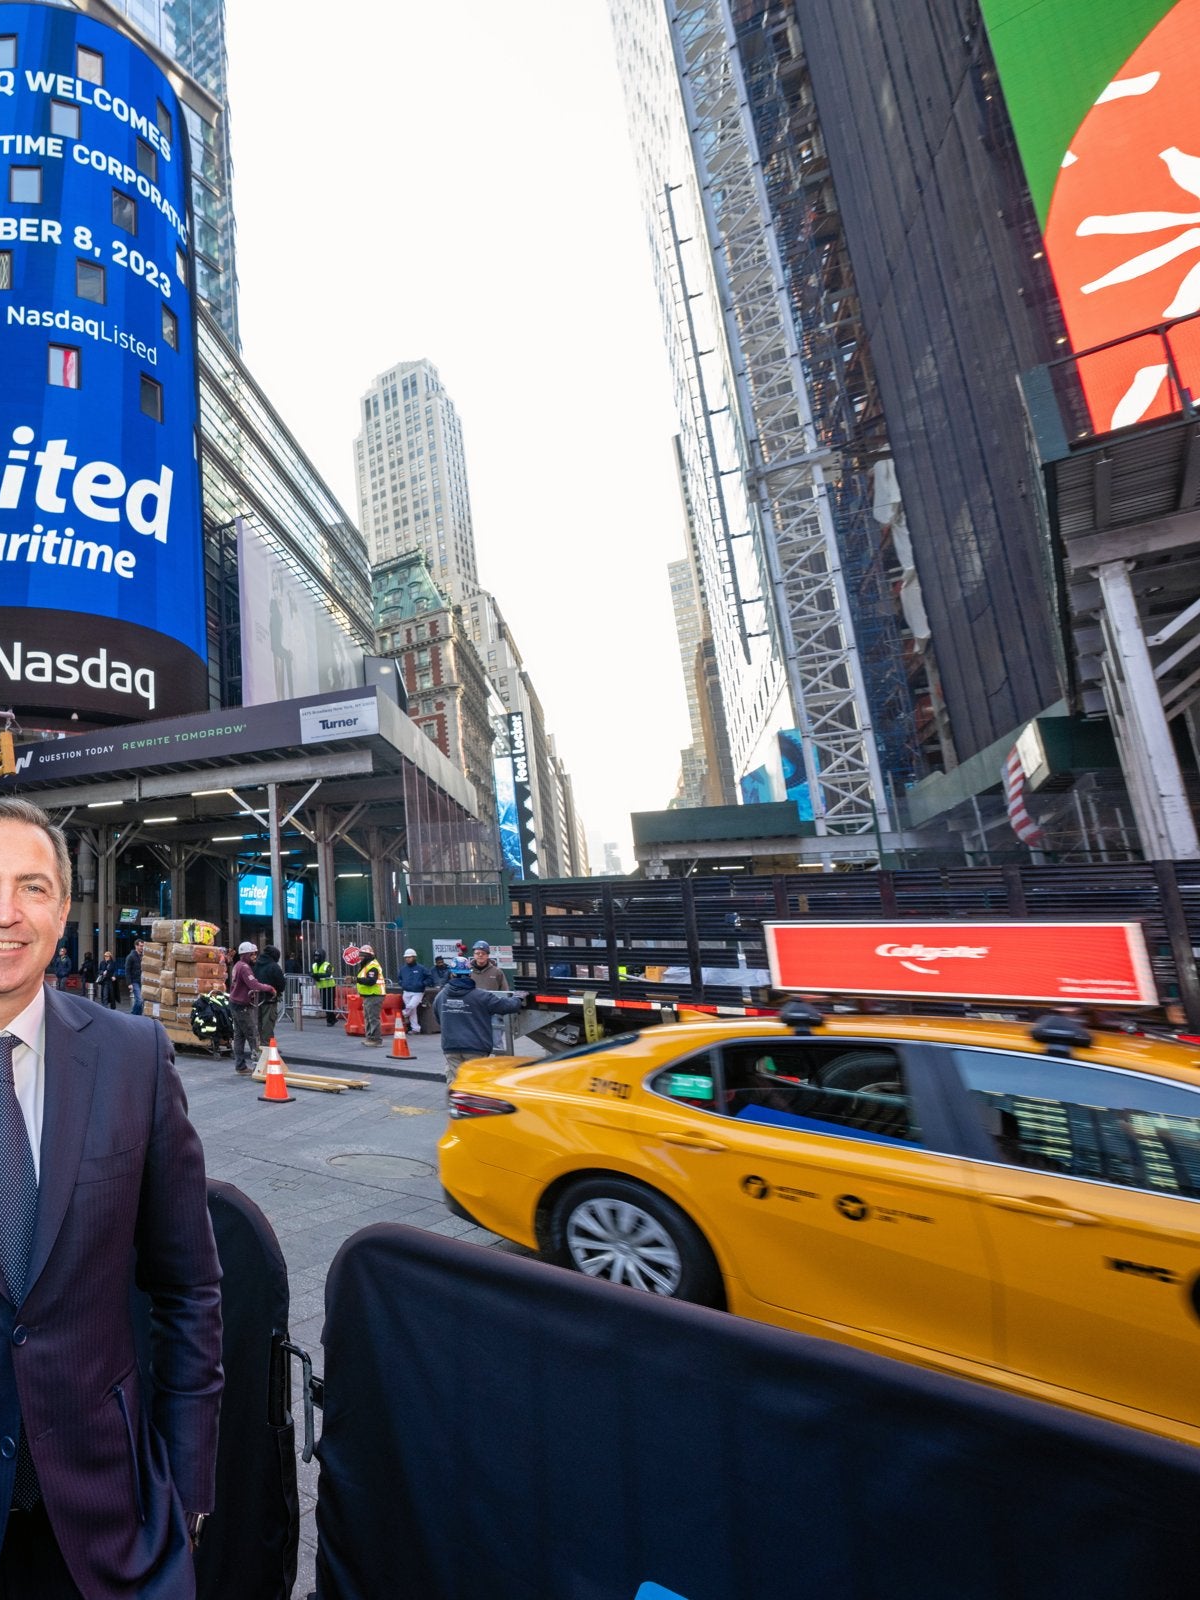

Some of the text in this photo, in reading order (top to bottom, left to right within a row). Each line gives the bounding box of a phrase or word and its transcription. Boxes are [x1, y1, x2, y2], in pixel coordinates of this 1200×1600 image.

[25, 70, 171, 162] WELCOMES
[73, 145, 188, 247] CORPORATIO
[73, 226, 101, 258] 8,
[112, 240, 171, 299] 2023
[7, 305, 157, 365] NasdaqListed
[39, 750, 82, 763] QUESTION
[85, 745, 114, 756] TODAY
[122, 736, 170, 751] REWRITE
[318, 717, 359, 730] Turner
[511, 715, 528, 782] Foot Locker
[240, 884, 268, 899] united
[344, 949, 360, 962] STOP
